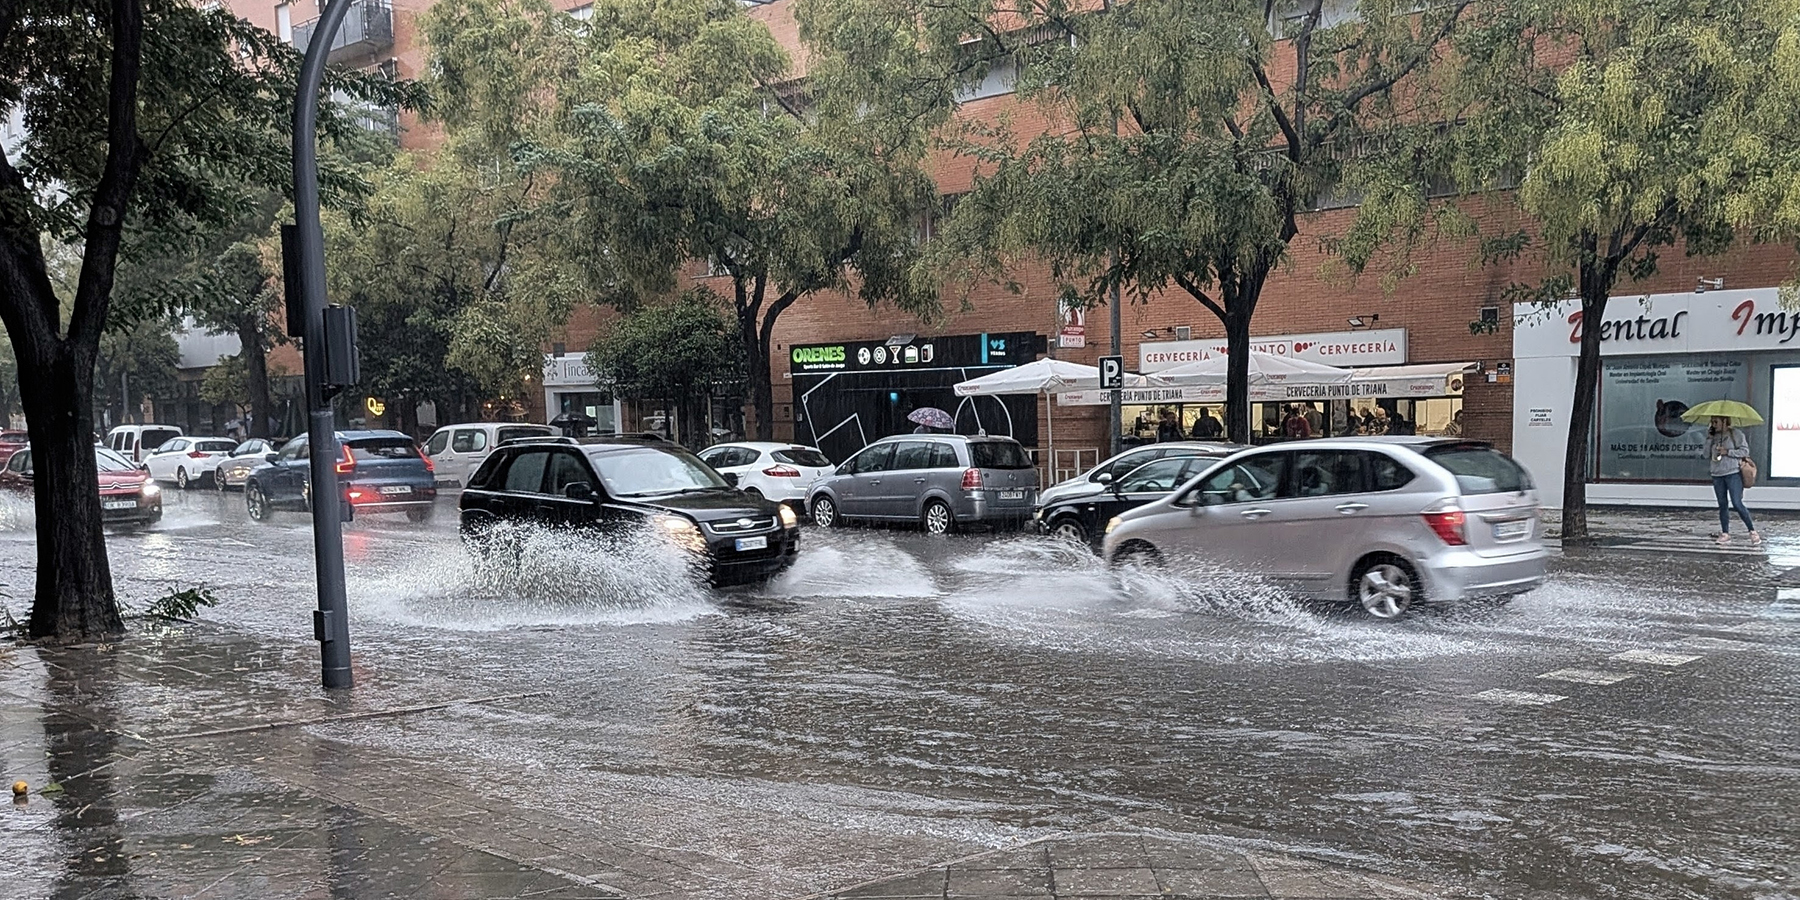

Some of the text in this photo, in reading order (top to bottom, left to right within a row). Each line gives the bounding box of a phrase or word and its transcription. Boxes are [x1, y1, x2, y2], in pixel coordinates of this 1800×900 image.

[990, 340, 1005, 350] VS
[1319, 340, 1397, 355] CERVECERÍA
[792, 346, 846, 363] ORENES
[1146, 349, 1211, 363] CERVECERÍA
[1104, 359, 1119, 387] P
[1100, 389, 1183, 402] CERERÍA PUNTO DE TRIANA
[1286, 383, 1387, 397] CERVECERÍA PUNTO DE TRIANA
[1611, 443, 1628, 451] MÁS
[1649, 443, 1670, 451] AÑOS
